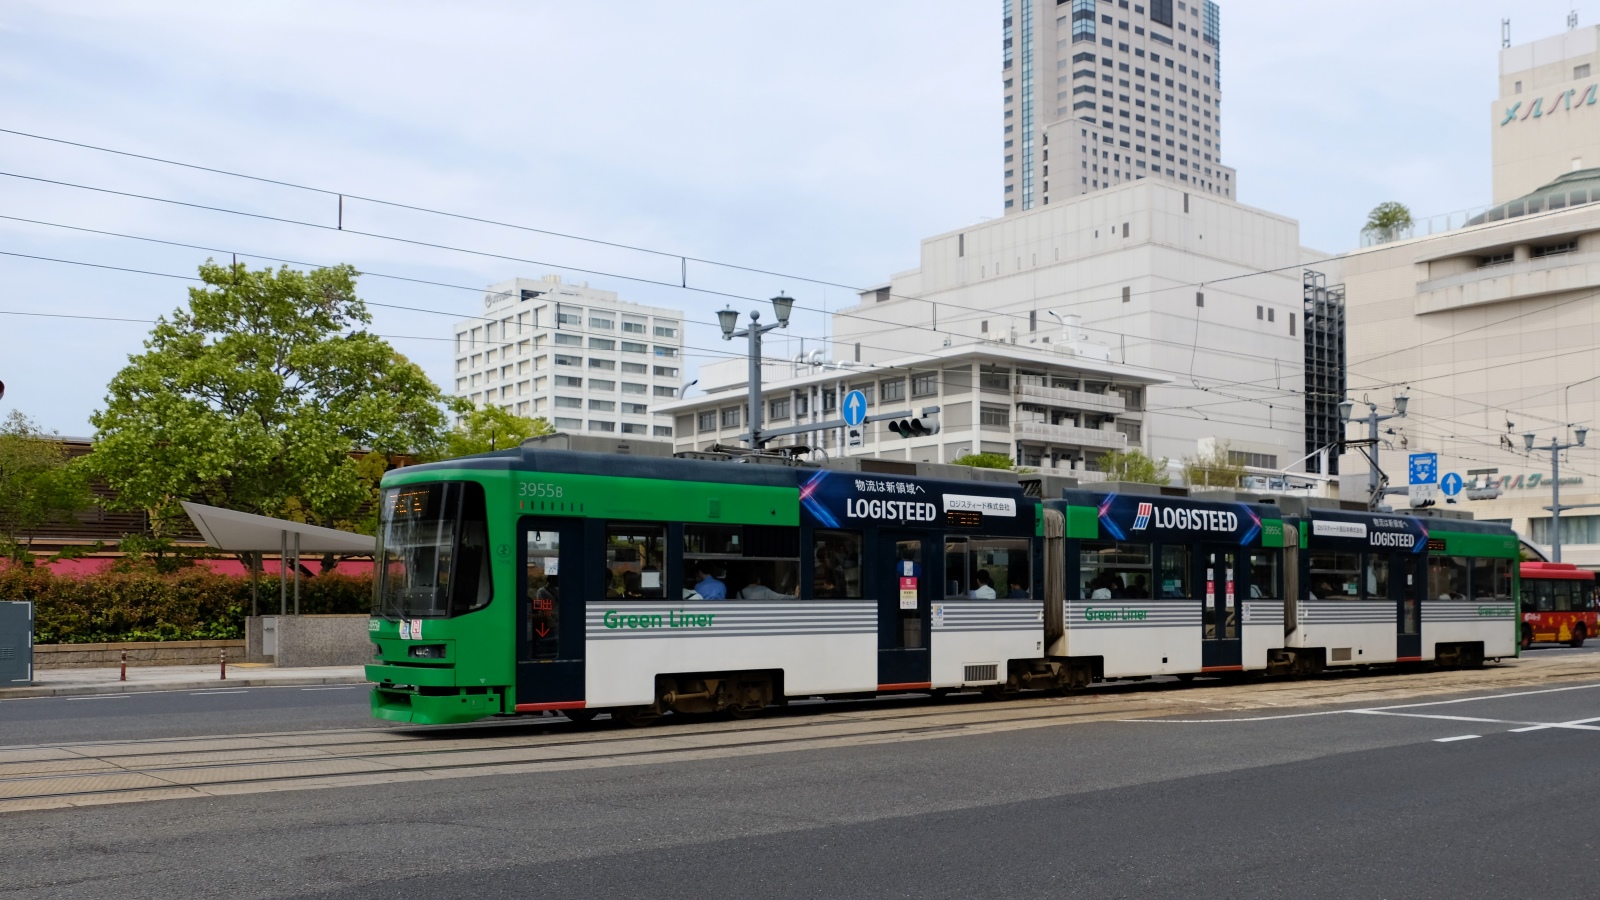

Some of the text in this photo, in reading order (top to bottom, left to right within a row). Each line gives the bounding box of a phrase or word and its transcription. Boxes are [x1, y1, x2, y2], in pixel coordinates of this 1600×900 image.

[518, 482, 563, 498] 3955B
[854, 479, 926, 495] 物流は新領域へ
[846, 498, 937, 522] LOGISTEED
[949, 500, 1010, 511] ロジスティード株式会社
[1153, 506, 1238, 532] LOGISTEED
[1370, 531, 1415, 548] LOGISTEED
[603, 609, 716, 629] Green Liner
[1085, 606, 1148, 621] Green Liner
